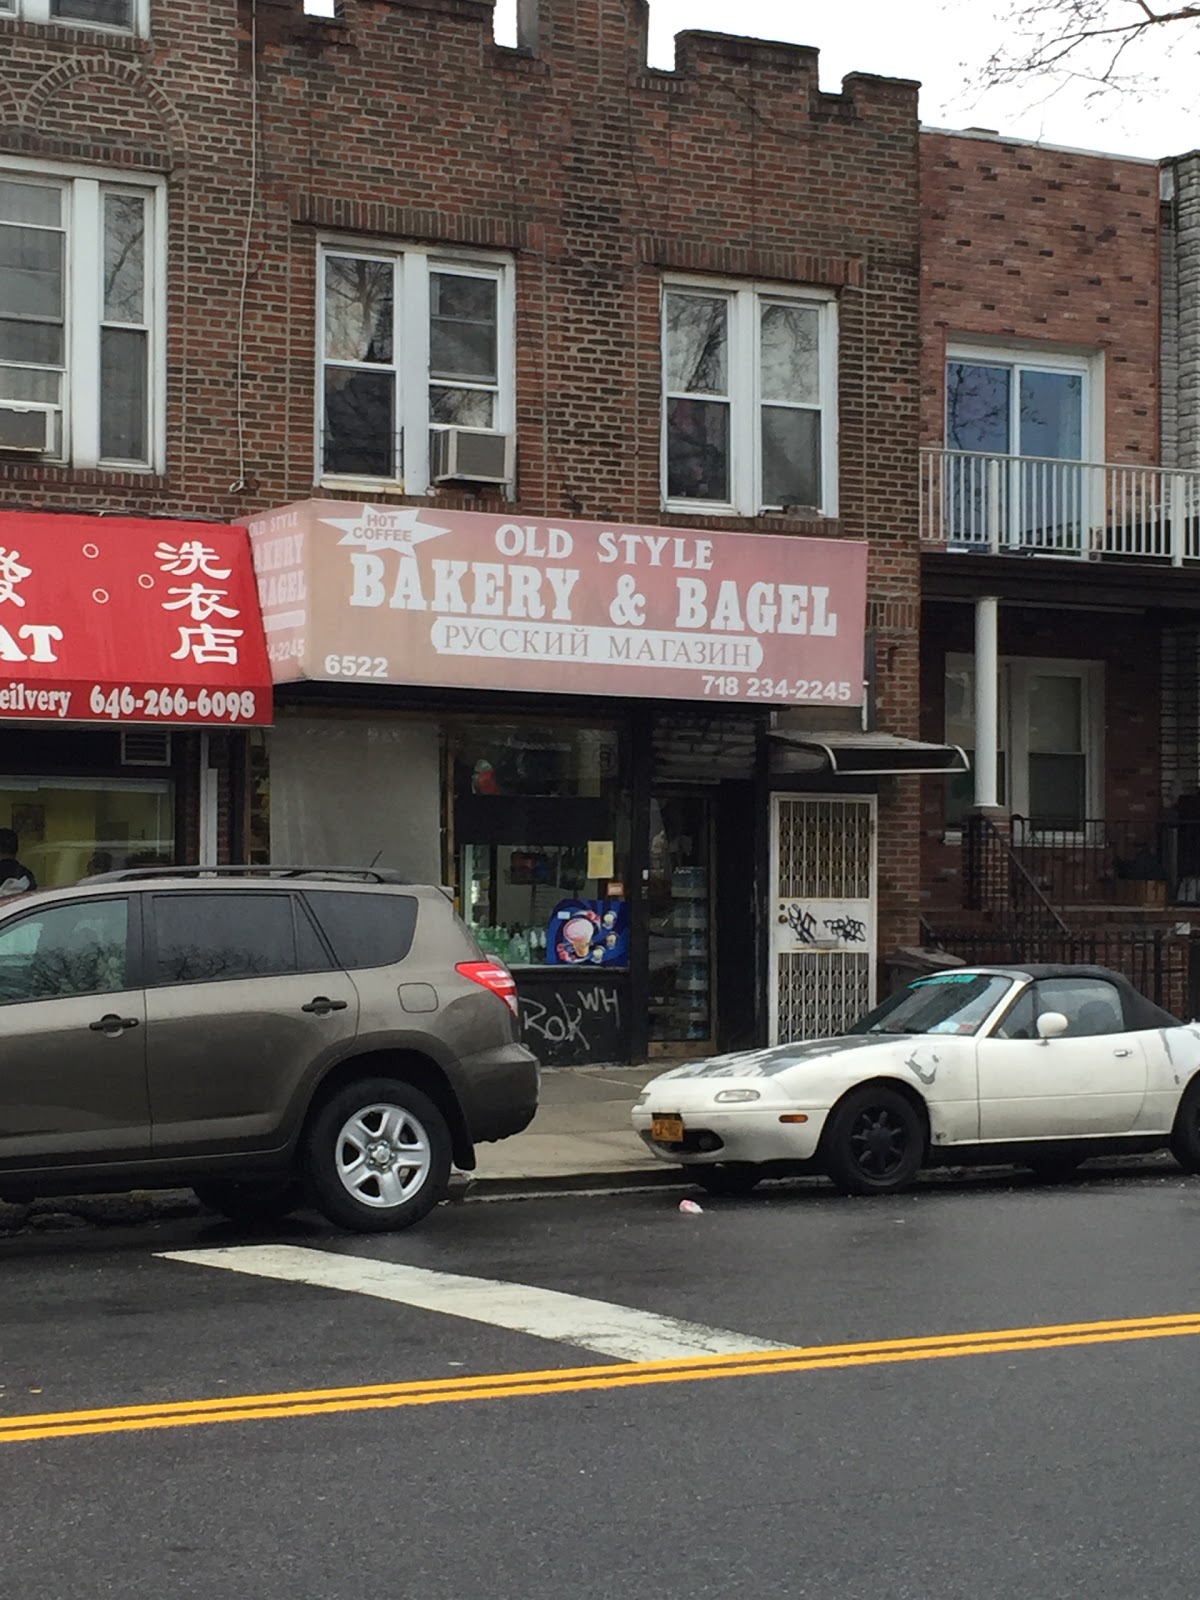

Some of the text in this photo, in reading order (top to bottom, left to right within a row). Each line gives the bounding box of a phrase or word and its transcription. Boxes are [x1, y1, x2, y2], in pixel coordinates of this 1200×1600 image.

[249, 511, 299, 538] OLD STYLE
[352, 527, 413, 542] COFFEE
[367, 514, 399, 528] HOT
[495, 524, 714, 570] OLD STYLE
[154, 540, 244, 665] 洗衣店
[350, 552, 838, 637] BAKERY & BAGEL
[444, 624, 751, 667] РУССКИЙ МАГАЗИН
[325, 654, 388, 678] 6522
[90, 685, 256, 722] 646-266-6098
[702, 675, 851, 701] 718 234-2245
